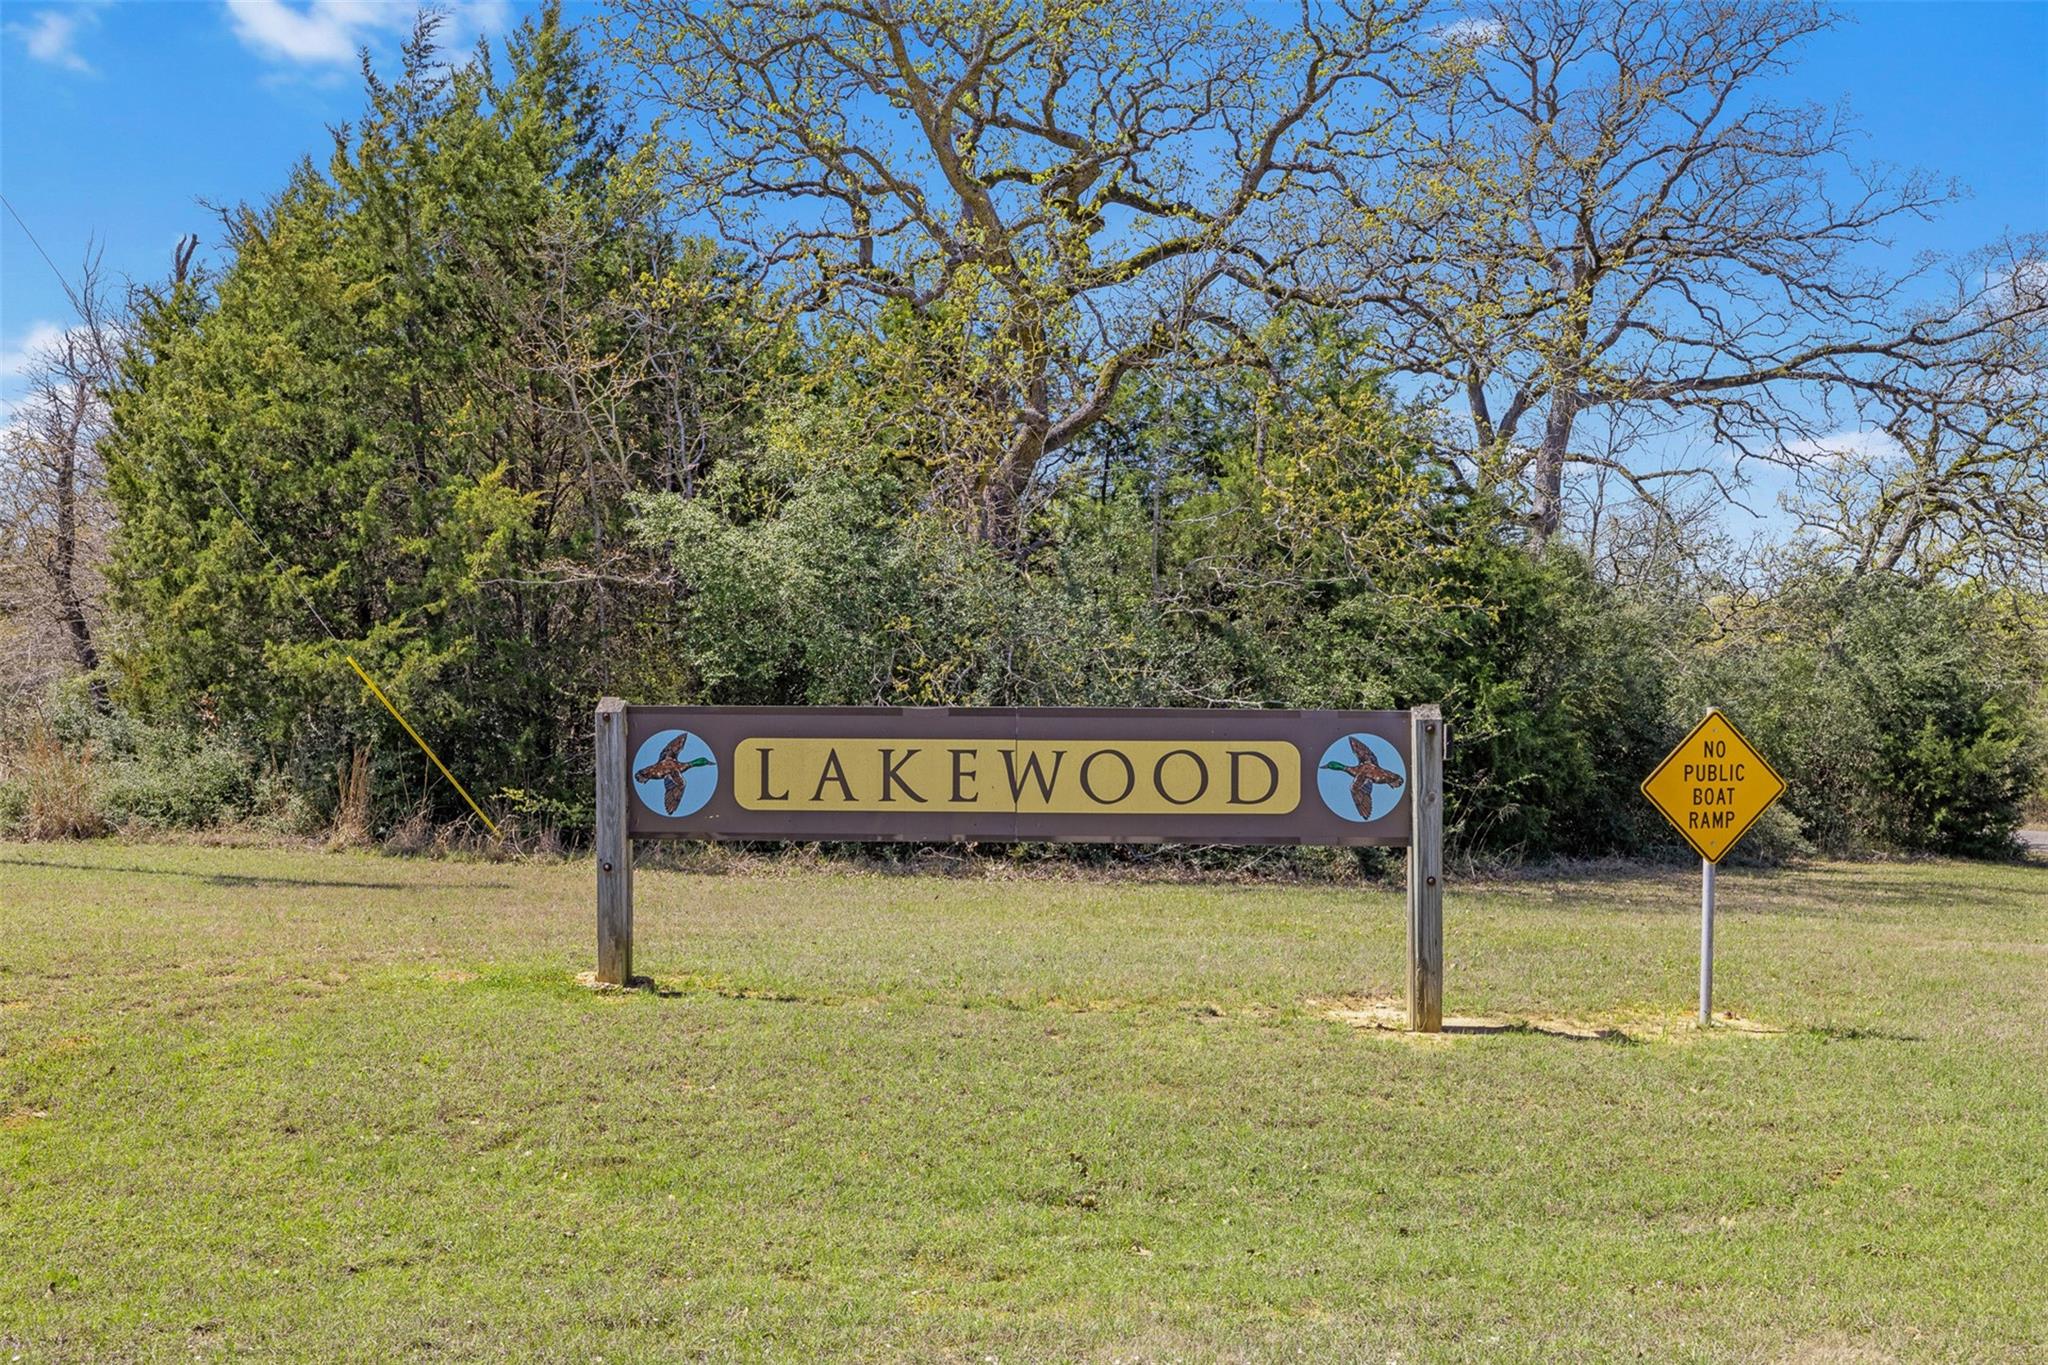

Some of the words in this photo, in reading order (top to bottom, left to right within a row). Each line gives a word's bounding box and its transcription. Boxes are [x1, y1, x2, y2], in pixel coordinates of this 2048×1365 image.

[1703, 740, 1726, 758] NO
[756, 747, 1279, 805] LAKEWOOD
[1683, 764, 1745, 782] PUBLIC
[1692, 787, 1735, 805] BOAT
[1688, 811, 1735, 829] RAMP
